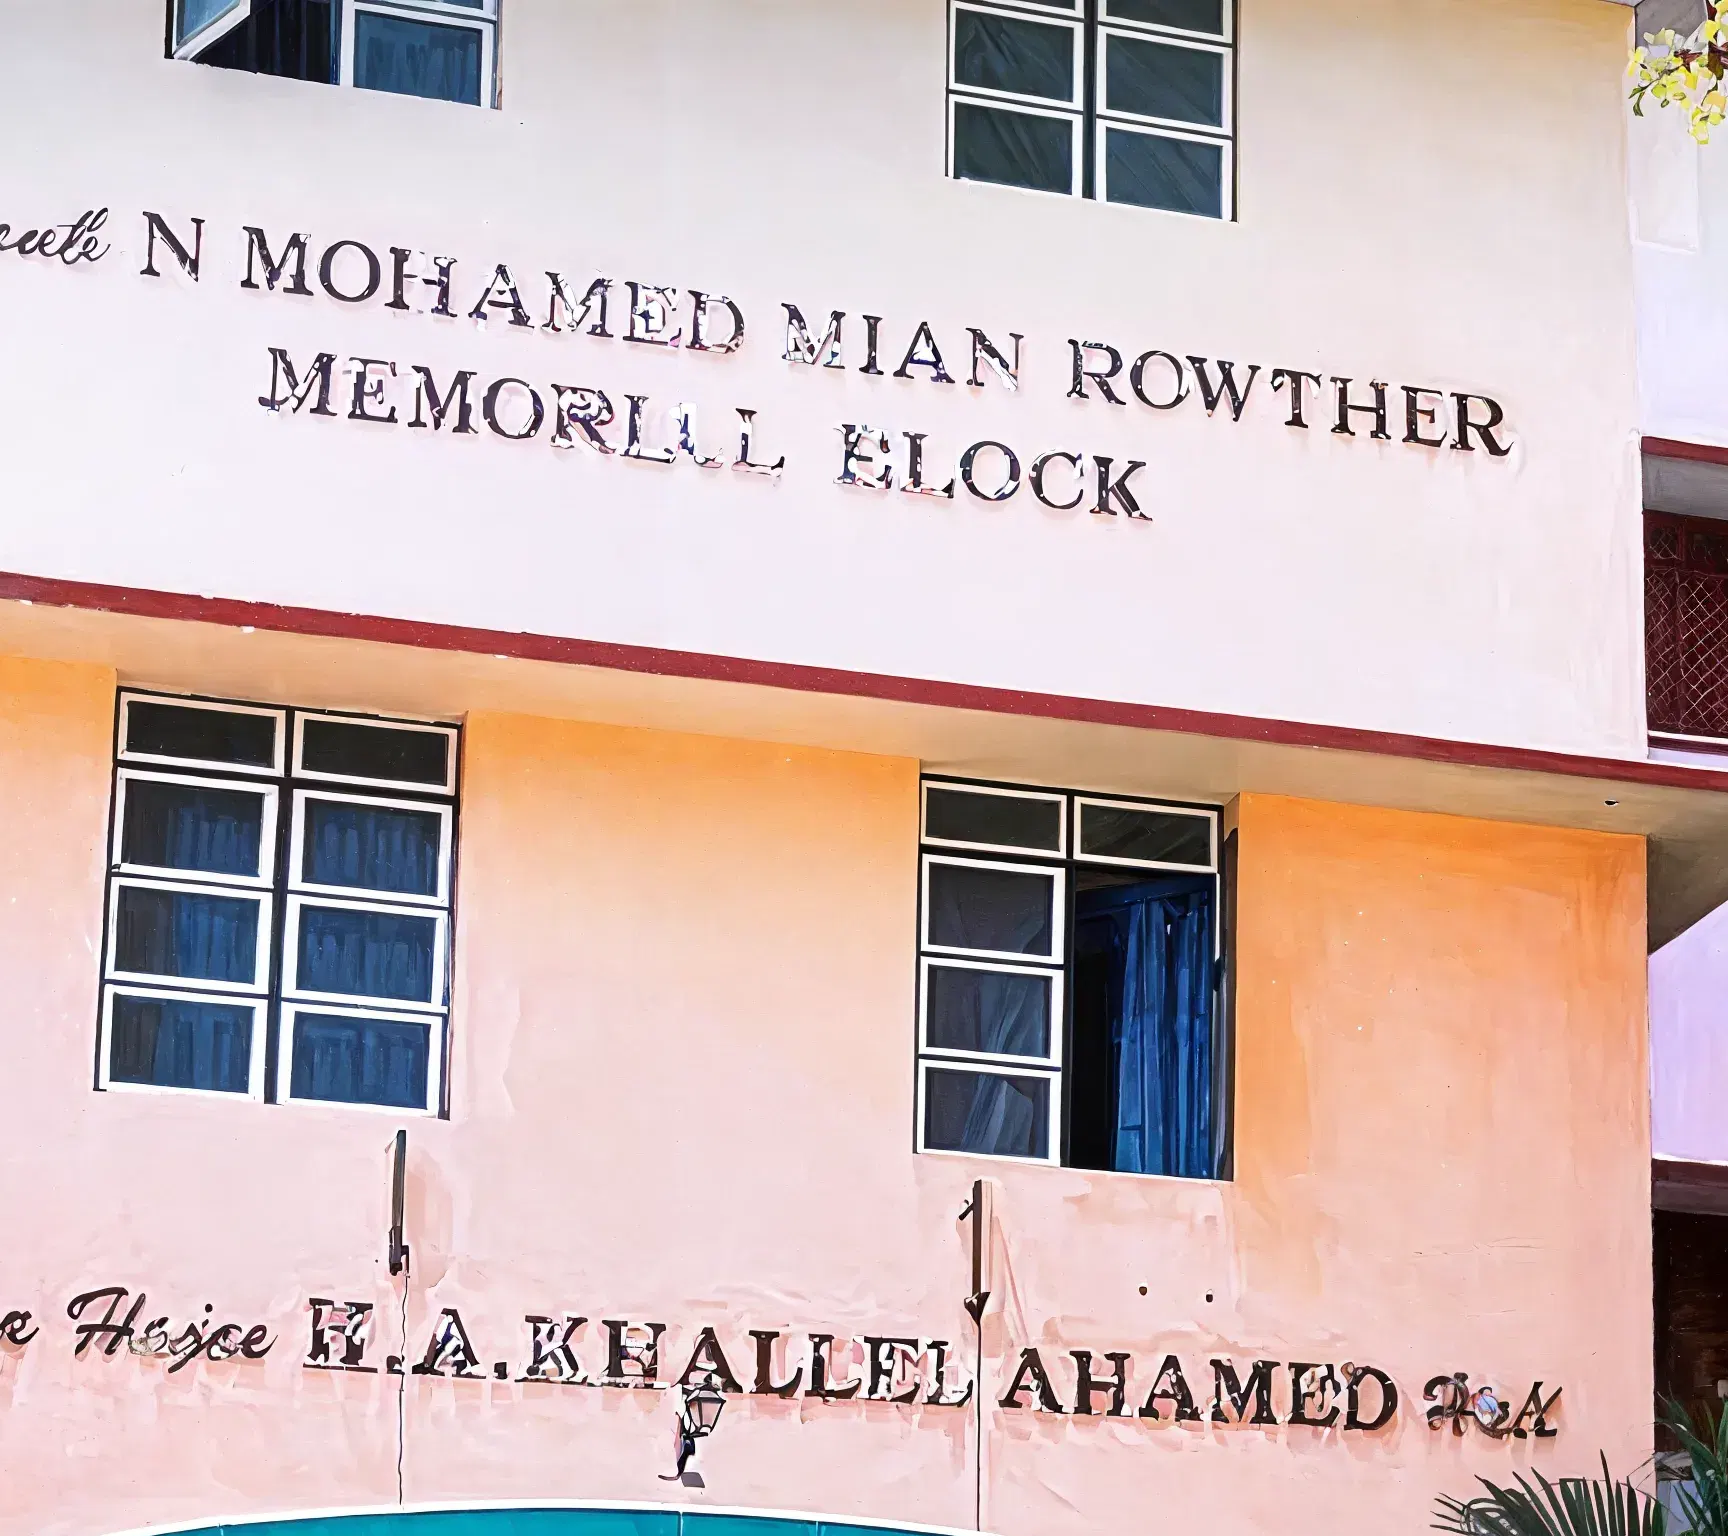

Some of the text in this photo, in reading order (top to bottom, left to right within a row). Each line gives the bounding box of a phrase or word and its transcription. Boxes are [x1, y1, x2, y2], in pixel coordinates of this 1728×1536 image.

[140, 211, 206, 283] N
[239, 225, 745, 355] MOHAMED
[780, 302, 1025, 392] MIAN
[1066, 338, 1517, 458] ROWTHER
[997, 1347, 1398, 1432] AHAMED
